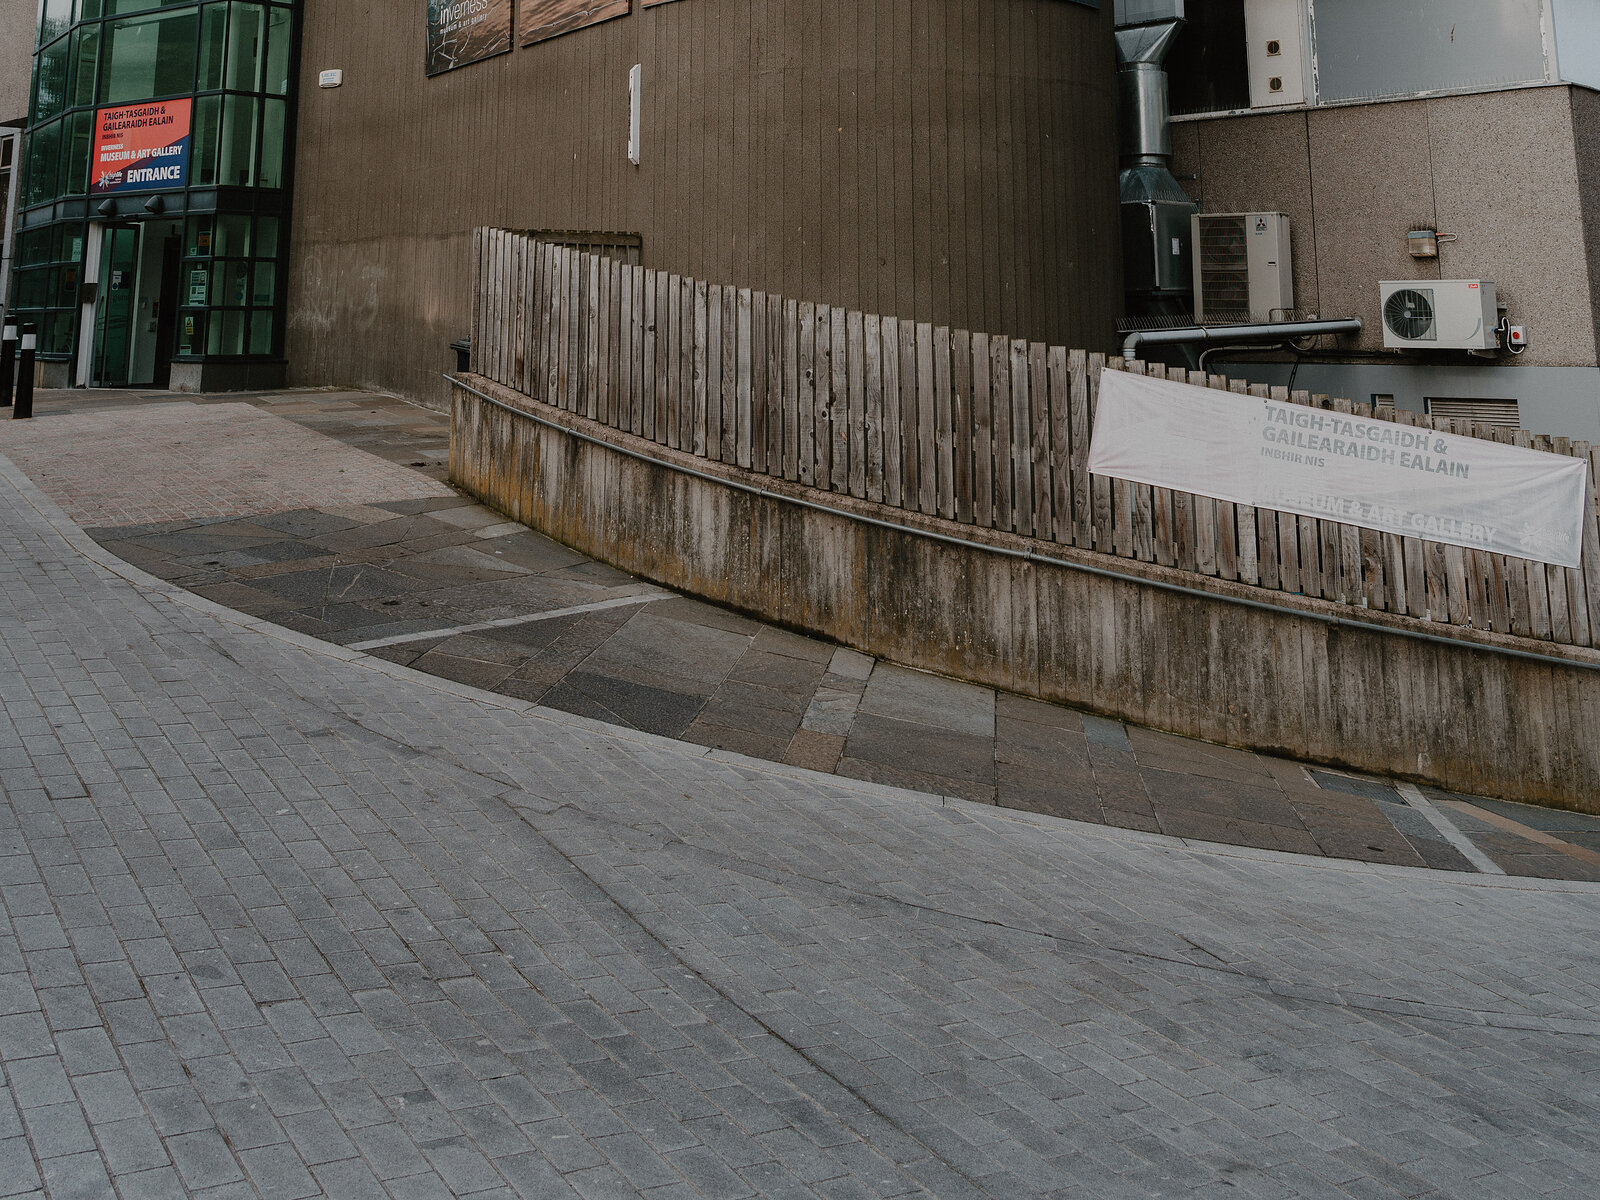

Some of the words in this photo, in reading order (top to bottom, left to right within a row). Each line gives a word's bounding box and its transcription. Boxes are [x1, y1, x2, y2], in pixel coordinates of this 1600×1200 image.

[104, 107, 159, 120] TAIGH-TASGAIDH
[161, 106, 166, 114] &
[103, 119, 148, 131] GAILEARAIDH
[149, 116, 173, 126] EALAIN
[100, 150, 130, 162] MUSEUM
[131, 149, 137, 160] &
[137, 148, 151, 159] ART
[152, 145, 183, 157] GALLERY
[127, 165, 181, 183] ENTRANCE
[1264, 405, 1430, 451] TAIGH-TASGAIDH
[1433, 438, 1448, 455] &
[1261, 446, 1303, 464] INBHIR
[1304, 455, 1325, 468] NIS
[1262, 426, 1395, 465] GAILEARAIDH
[1400, 451, 1470, 479] EALAIN
[1411, 513, 1497, 543] GALLERY
